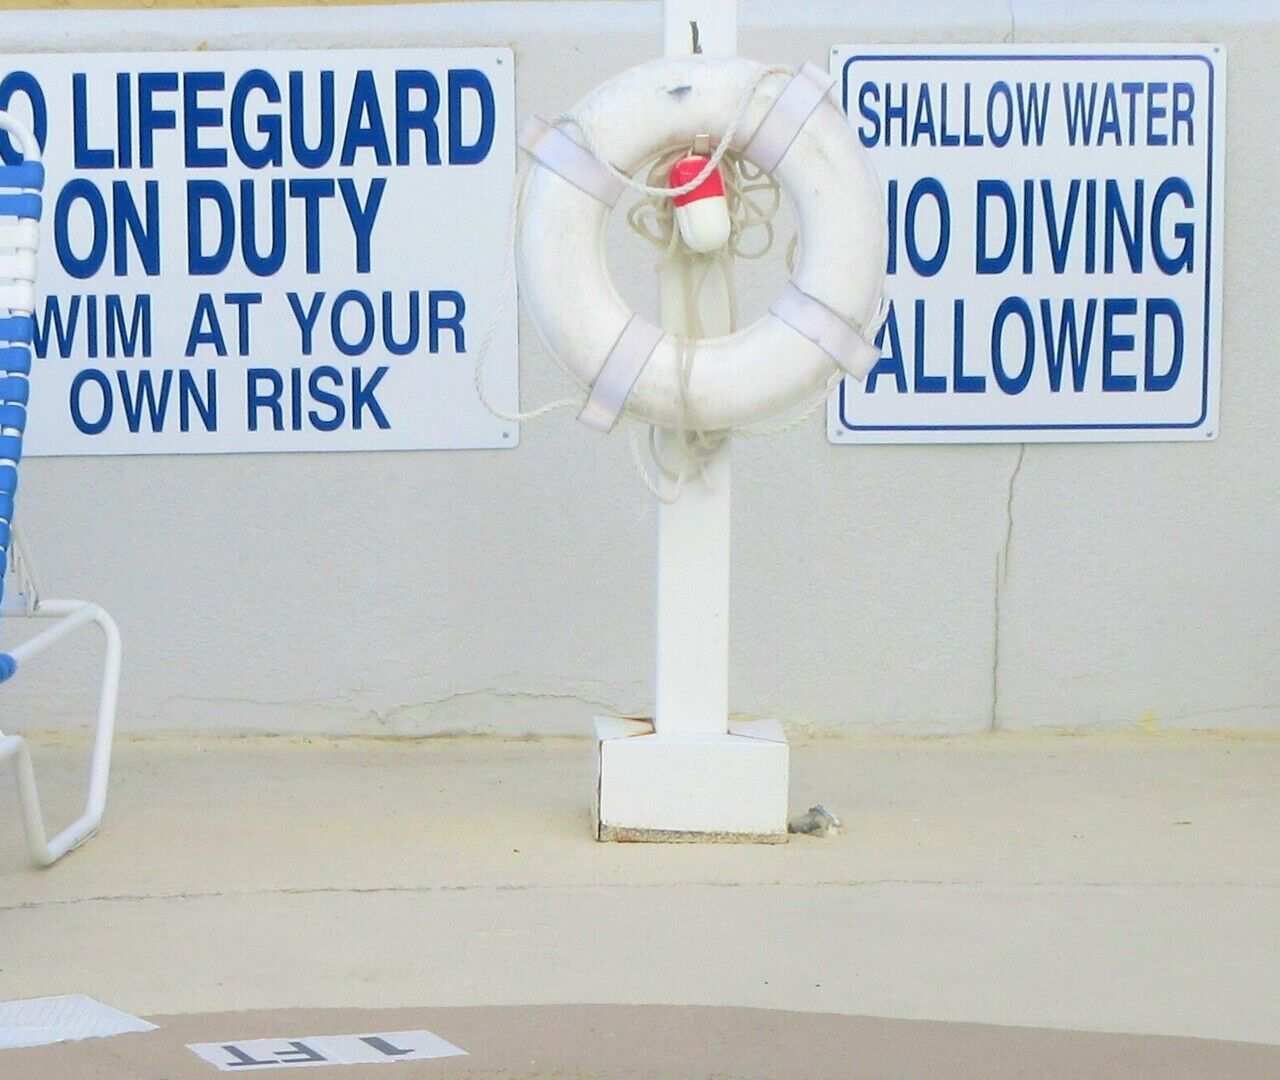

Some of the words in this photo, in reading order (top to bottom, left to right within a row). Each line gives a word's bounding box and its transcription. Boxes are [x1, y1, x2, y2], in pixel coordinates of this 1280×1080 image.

[72, 69, 496, 169] LIFEGUARD
[858, 80, 1051, 149] SHALLOW
[1063, 80, 1195, 147] WATER
[54, 178, 160, 279] ON
[187, 177, 388, 276] DUTY
[975, 176, 1195, 277] DIVING
[185, 292, 262, 358] AT
[286, 290, 467, 357] YOUR
[865, 296, 1185, 396] ALLOWED
[70, 368, 218, 435] OWN
[246, 366, 392, 432] RISK
[223, 1041, 329, 1067] FT
[358, 1035, 416, 1056] 1
